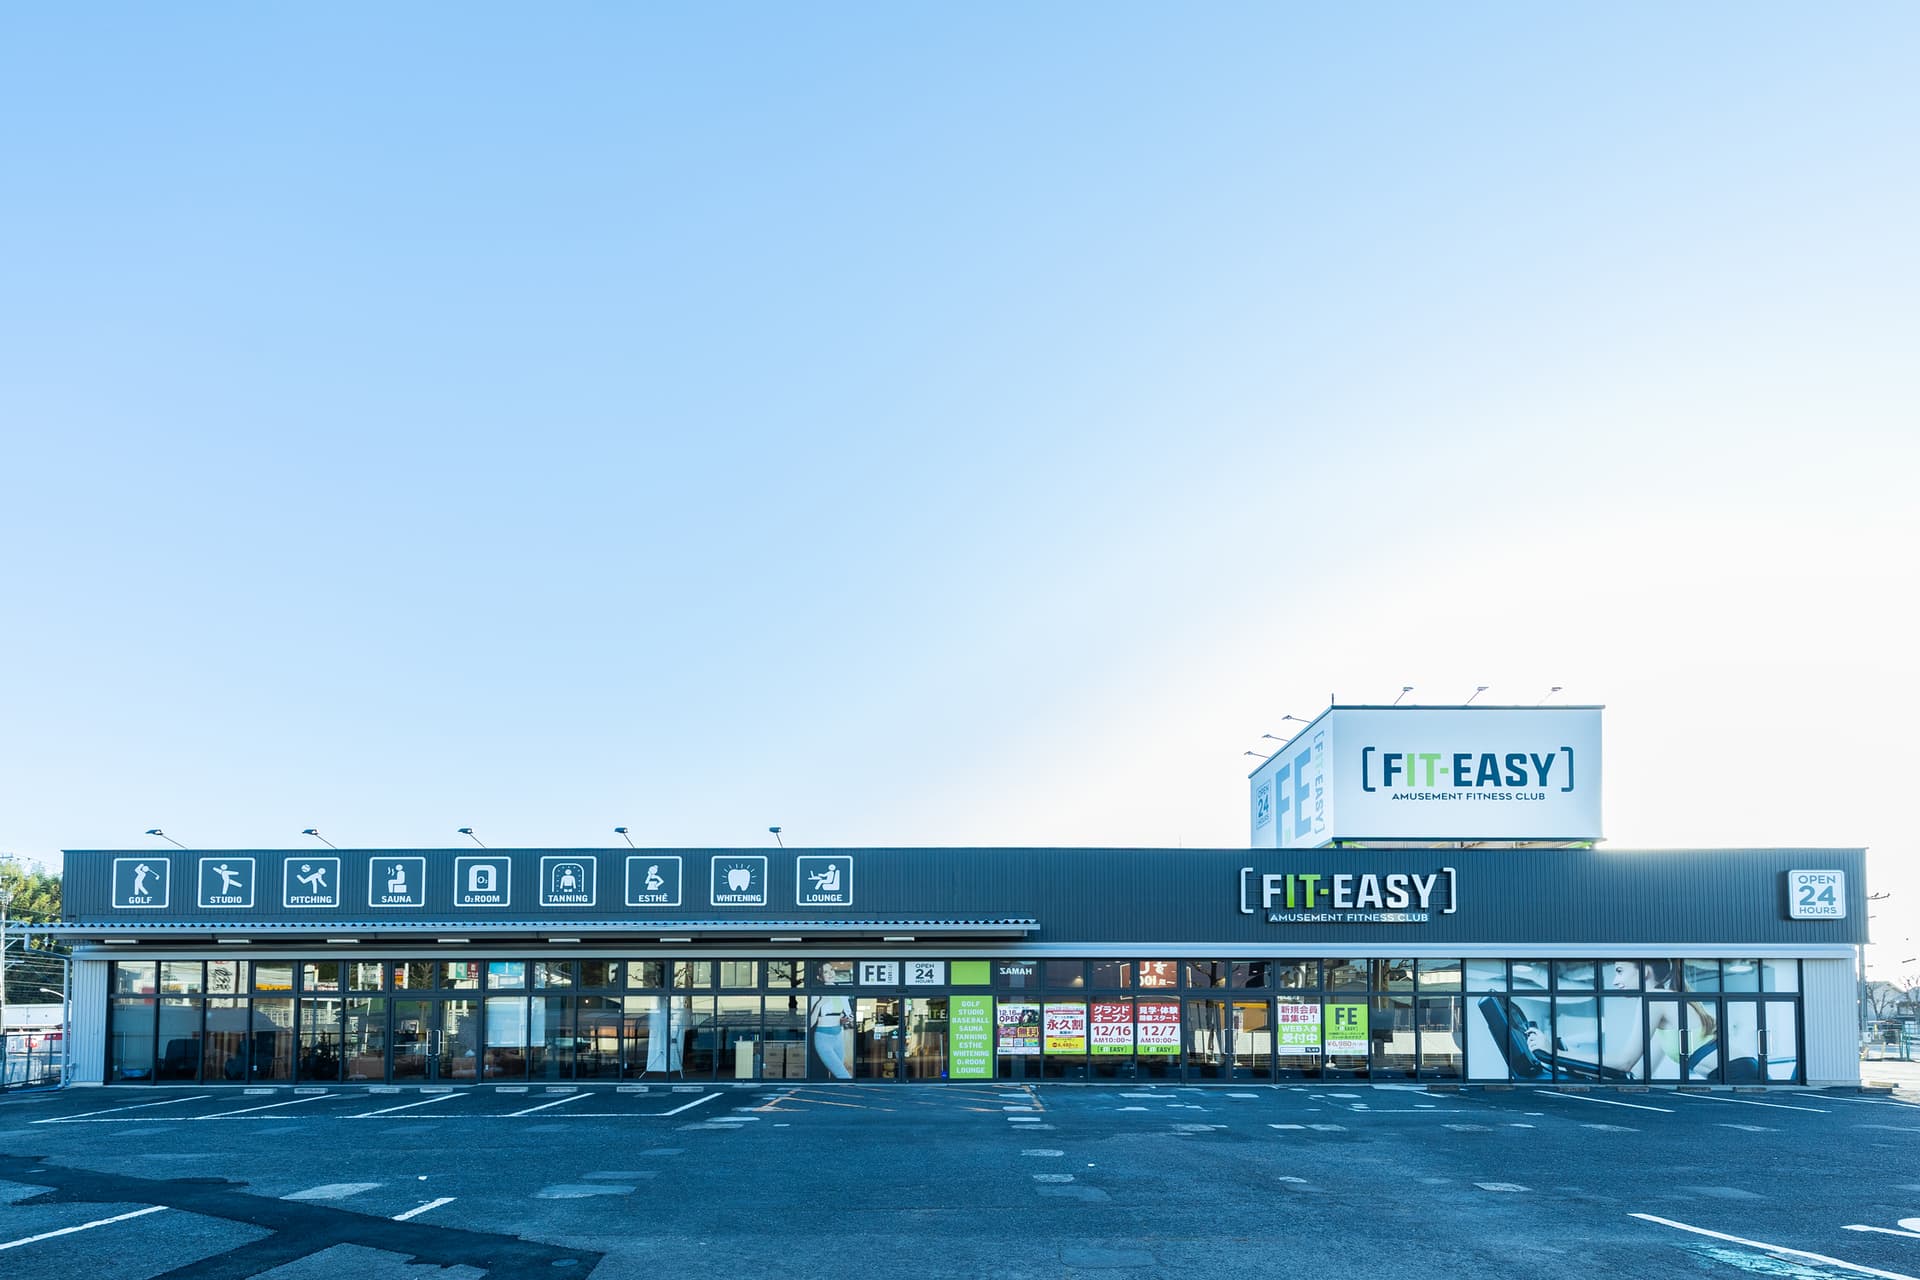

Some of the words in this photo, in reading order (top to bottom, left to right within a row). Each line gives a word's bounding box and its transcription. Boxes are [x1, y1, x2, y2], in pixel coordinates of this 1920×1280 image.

[1391, 792, 1464, 801] AMUSEMENT
[1466, 792, 1513, 801] FITNESS
[1515, 792, 1546, 801] CLUB
[1257, 795, 1269, 818] 24
[1798, 875, 1836, 884] OPEN
[209, 895, 243, 904] STUDIO
[290, 895, 332, 904] PITCHING
[381, 895, 412, 903] SAUNA
[547, 894, 588, 903] TANNING
[716, 894, 762, 903] WHITENING
[806, 894, 842, 902] LOUNGE
[1798, 885, 1837, 906] 24
[128, 896, 153, 905] GOLF
[1799, 906, 1837, 914] HOURS
[1270, 913, 1344, 922] AMUSEMENT
[1347, 913, 1397, 922] FITNESS
[1399, 913, 1428, 922] CLUB
[915, 969, 935, 979] 24
[961, 1000, 981, 1008] GOLF
[1094, 1005, 1130, 1014] グランド
[1281, 1005, 1318, 1014] 新規会員
[1094, 1014, 1130, 1023] オープン
[1046, 1019, 1084, 1031] 永久割
[1093, 1025, 1131, 1036] 12/16
[1142, 1025, 1177, 1036] 12/7
[1282, 1033, 1318, 1044] 受付中
[956, 1066, 985, 1074] LOUNGE
